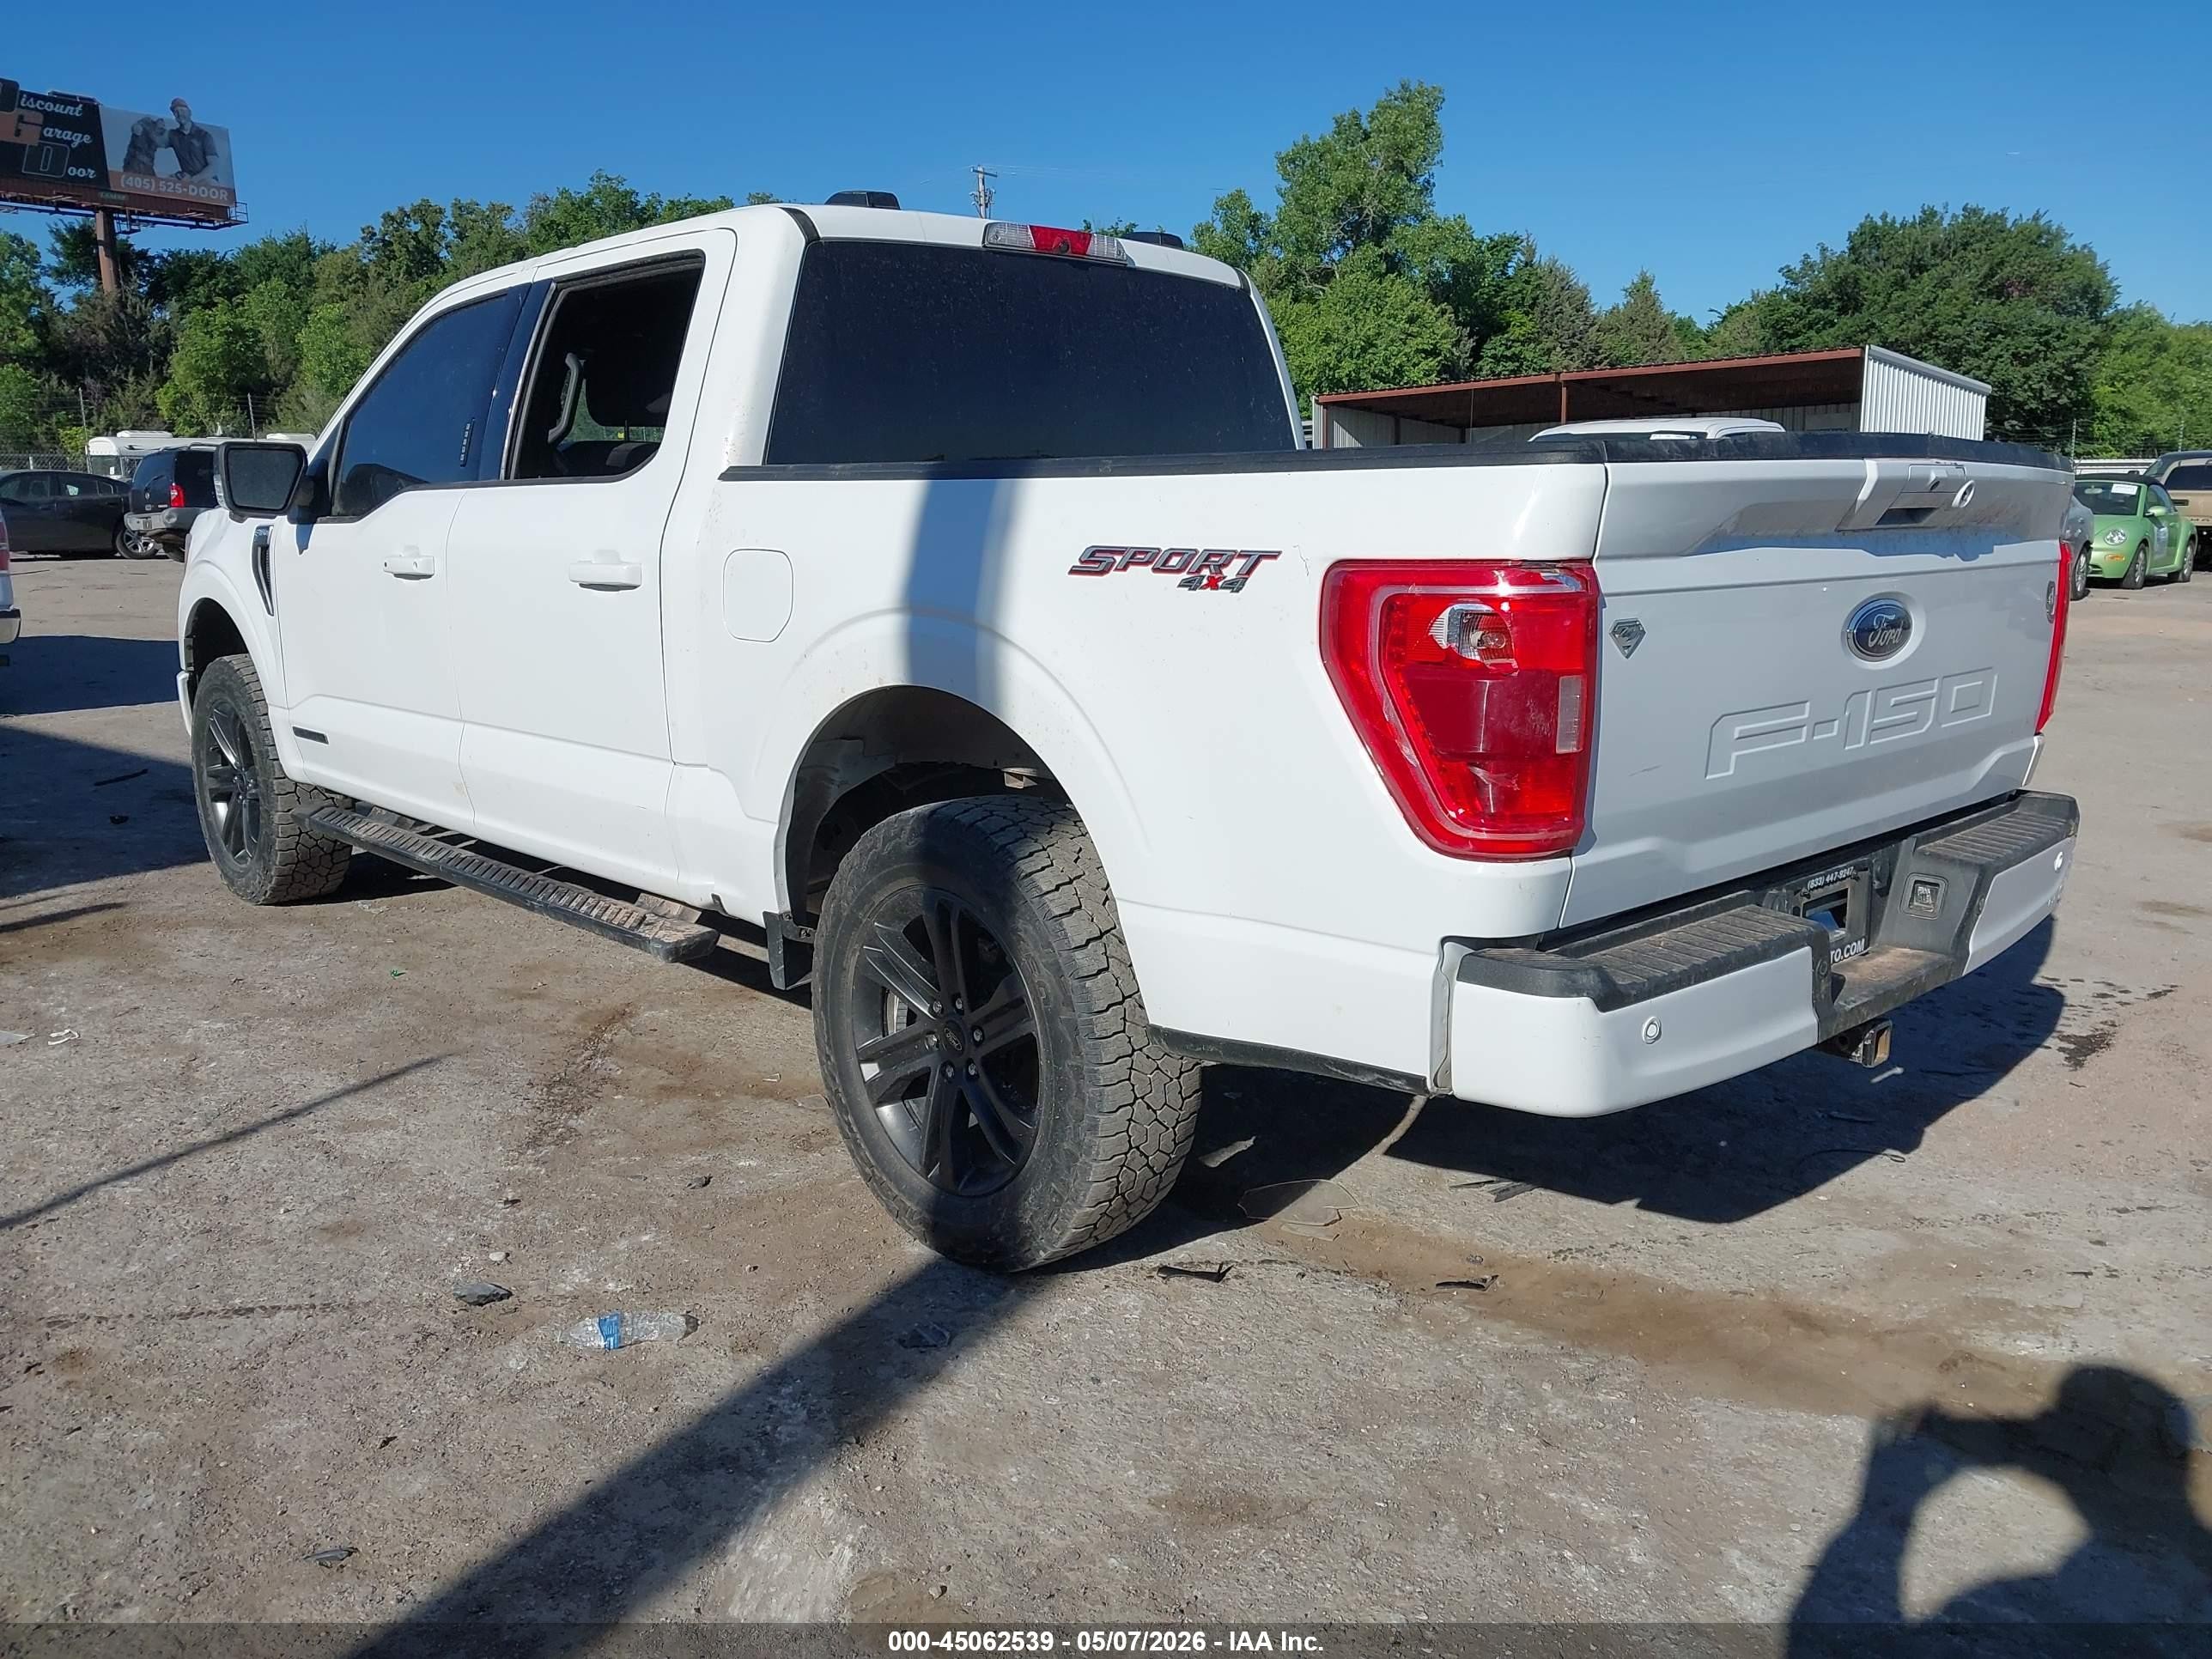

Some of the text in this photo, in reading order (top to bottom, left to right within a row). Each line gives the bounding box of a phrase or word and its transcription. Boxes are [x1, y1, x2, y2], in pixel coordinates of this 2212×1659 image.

[120, 174, 228, 201] (405) 525-DOOR
[1068, 544, 1283, 577] SPORT
[1868, 613, 1904, 647] Ford
[1705, 667, 1999, 781] F-150
[1807, 875, 1825, 890] (833)
